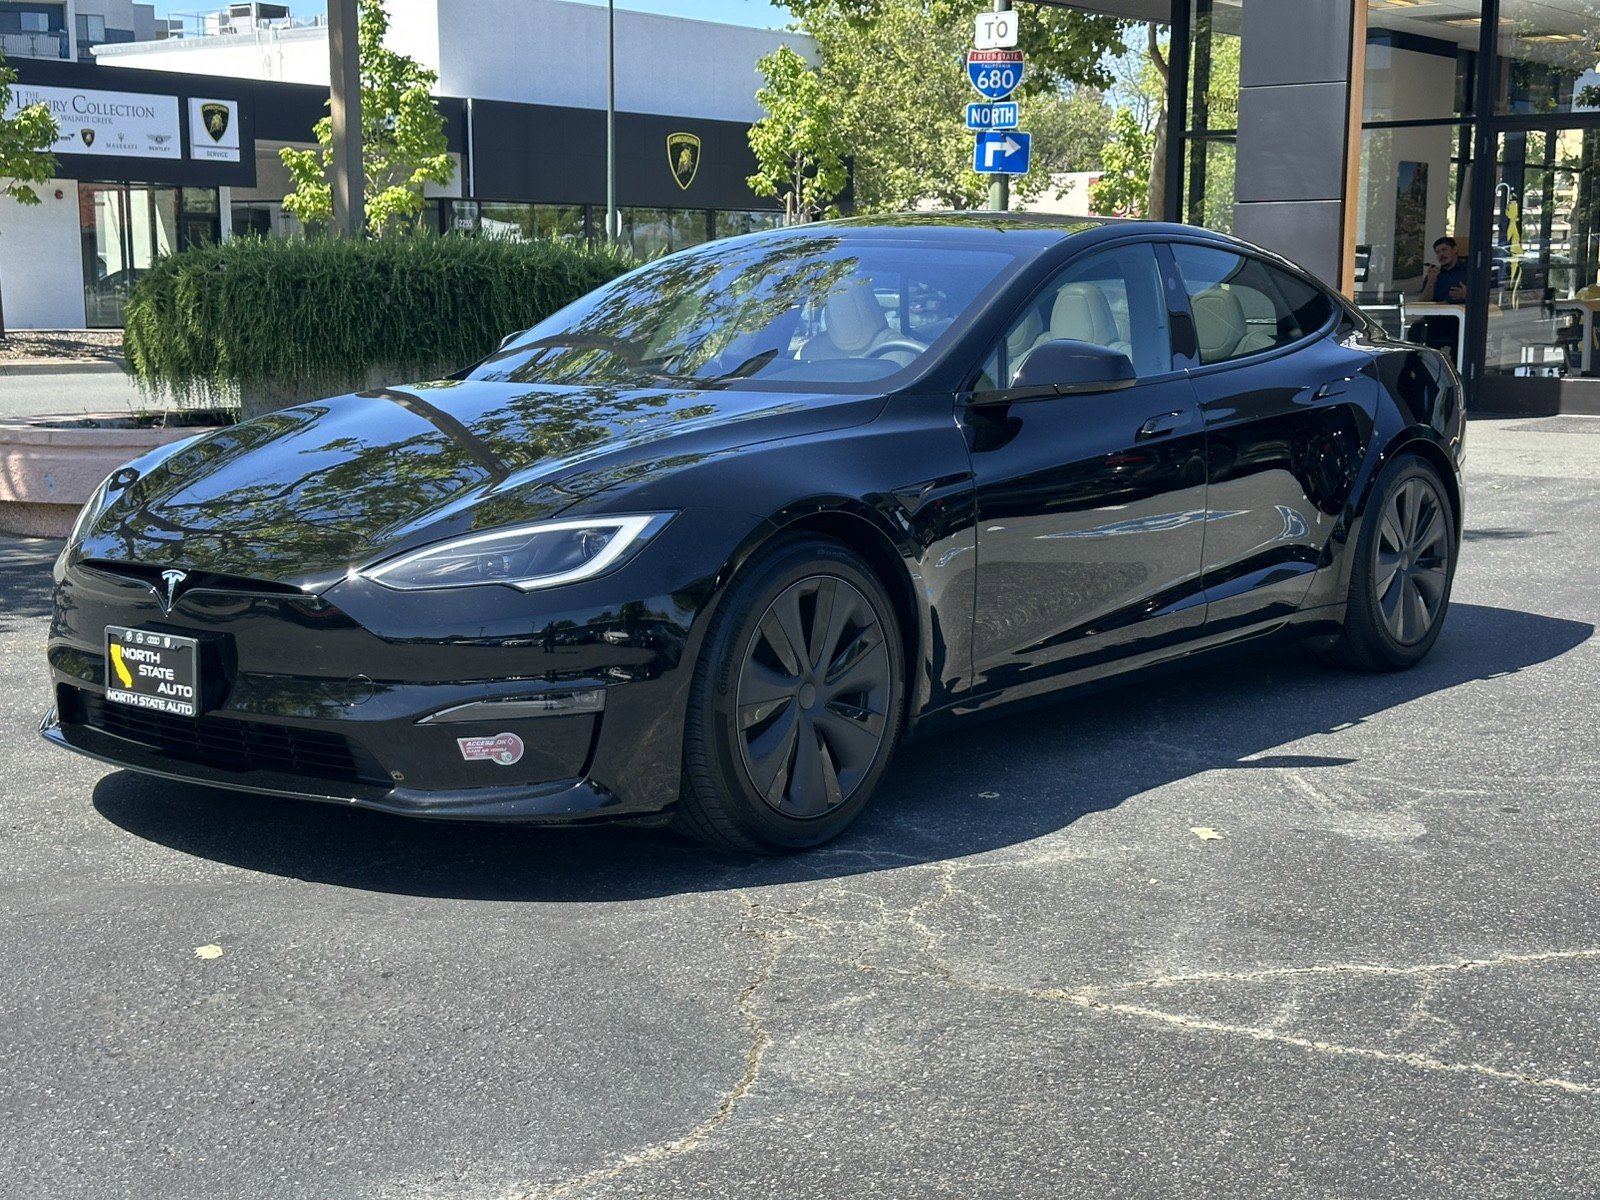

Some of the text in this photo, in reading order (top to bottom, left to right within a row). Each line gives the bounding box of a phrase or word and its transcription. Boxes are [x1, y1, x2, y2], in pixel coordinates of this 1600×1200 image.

[984, 20, 1008, 40] TO
[973, 51, 1019, 61] INTERSTATE
[977, 70, 1014, 89] 680
[72, 94, 155, 119] COLLECTION
[61, 114, 114, 125] WALNUT CREEK
[971, 107, 1014, 125] NORTH
[106, 142, 138, 150] MASERATI
[206, 150, 229, 158] SERVICE
[121, 646, 161, 664] NORTH
[138, 664, 175, 681] STATE
[157, 682, 193, 698] AUTO
[107, 689, 192, 715] NORTH STATE AUTO
